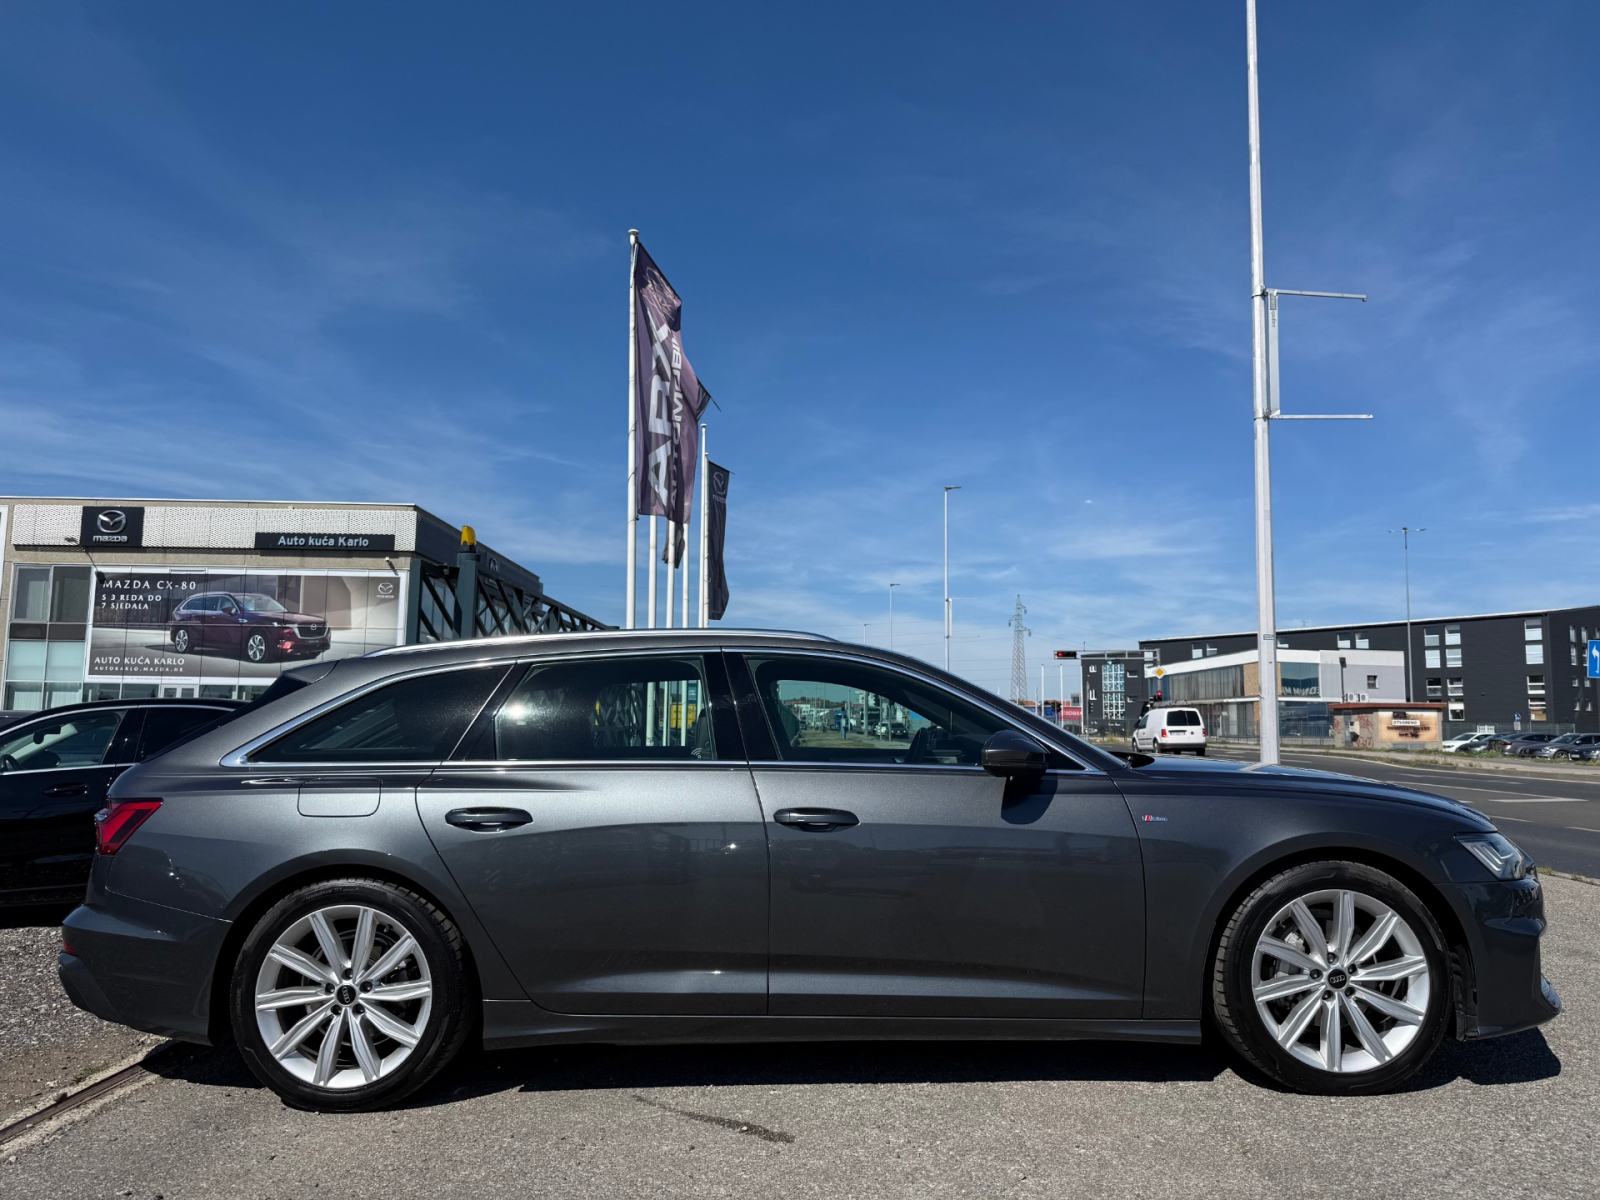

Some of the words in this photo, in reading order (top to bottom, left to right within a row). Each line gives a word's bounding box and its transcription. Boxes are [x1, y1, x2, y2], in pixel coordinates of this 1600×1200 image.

[277, 535, 305, 546] Auto
[308, 535, 334, 546] kuća
[338, 536, 369, 547] Karlo
[102, 580, 150, 589] MAZDA
[156, 580, 196, 590] CX-80
[110, 602, 149, 610] SJEDALA
[94, 656, 120, 664] AUTO
[124, 656, 150, 665] KUĆA
[154, 657, 185, 665] KARLO
